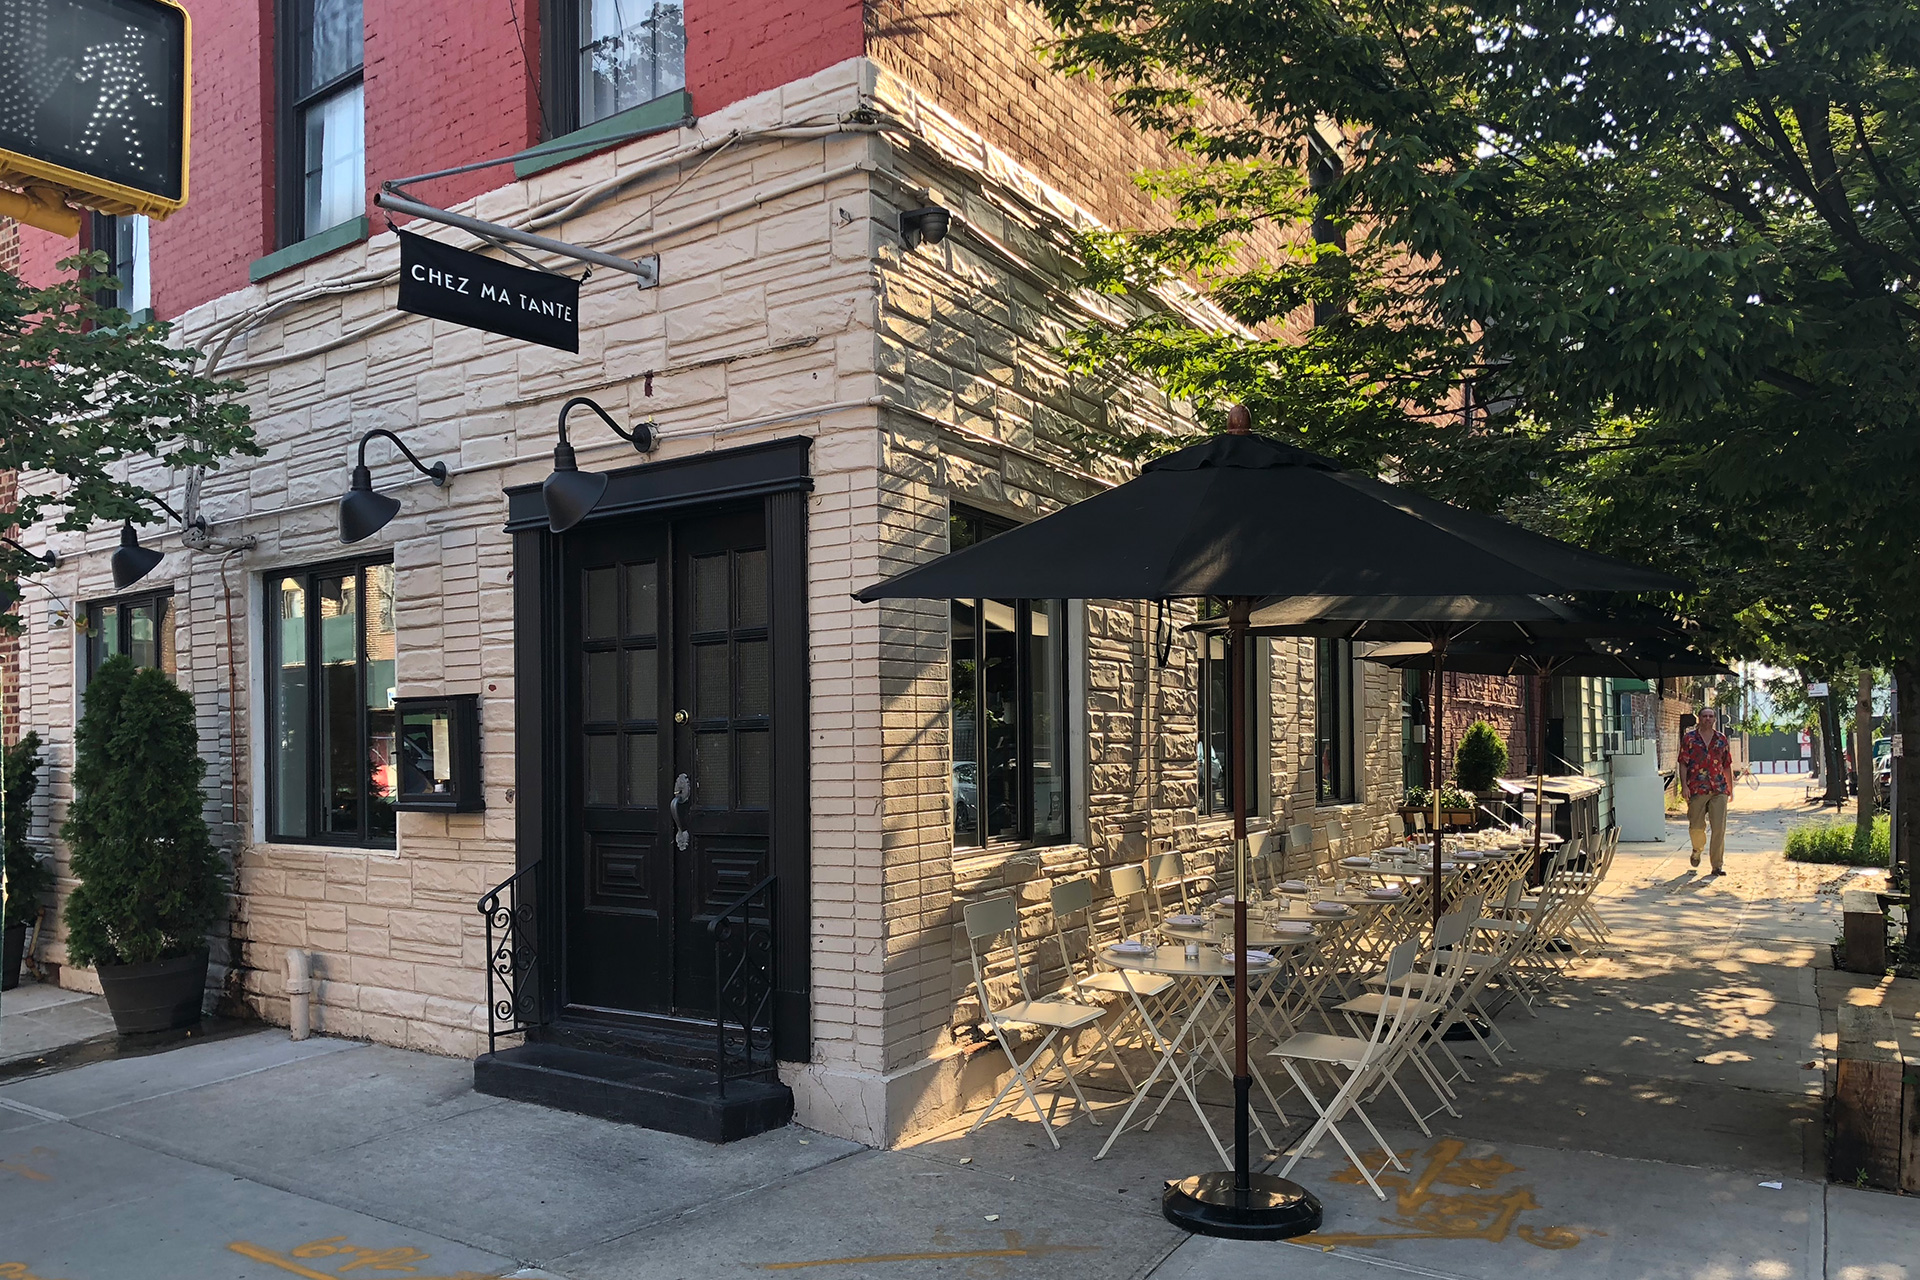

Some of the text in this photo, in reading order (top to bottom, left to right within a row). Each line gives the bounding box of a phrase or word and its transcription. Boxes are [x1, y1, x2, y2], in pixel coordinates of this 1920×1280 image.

[411, 264, 572, 322] CHEZ MA TANTE
